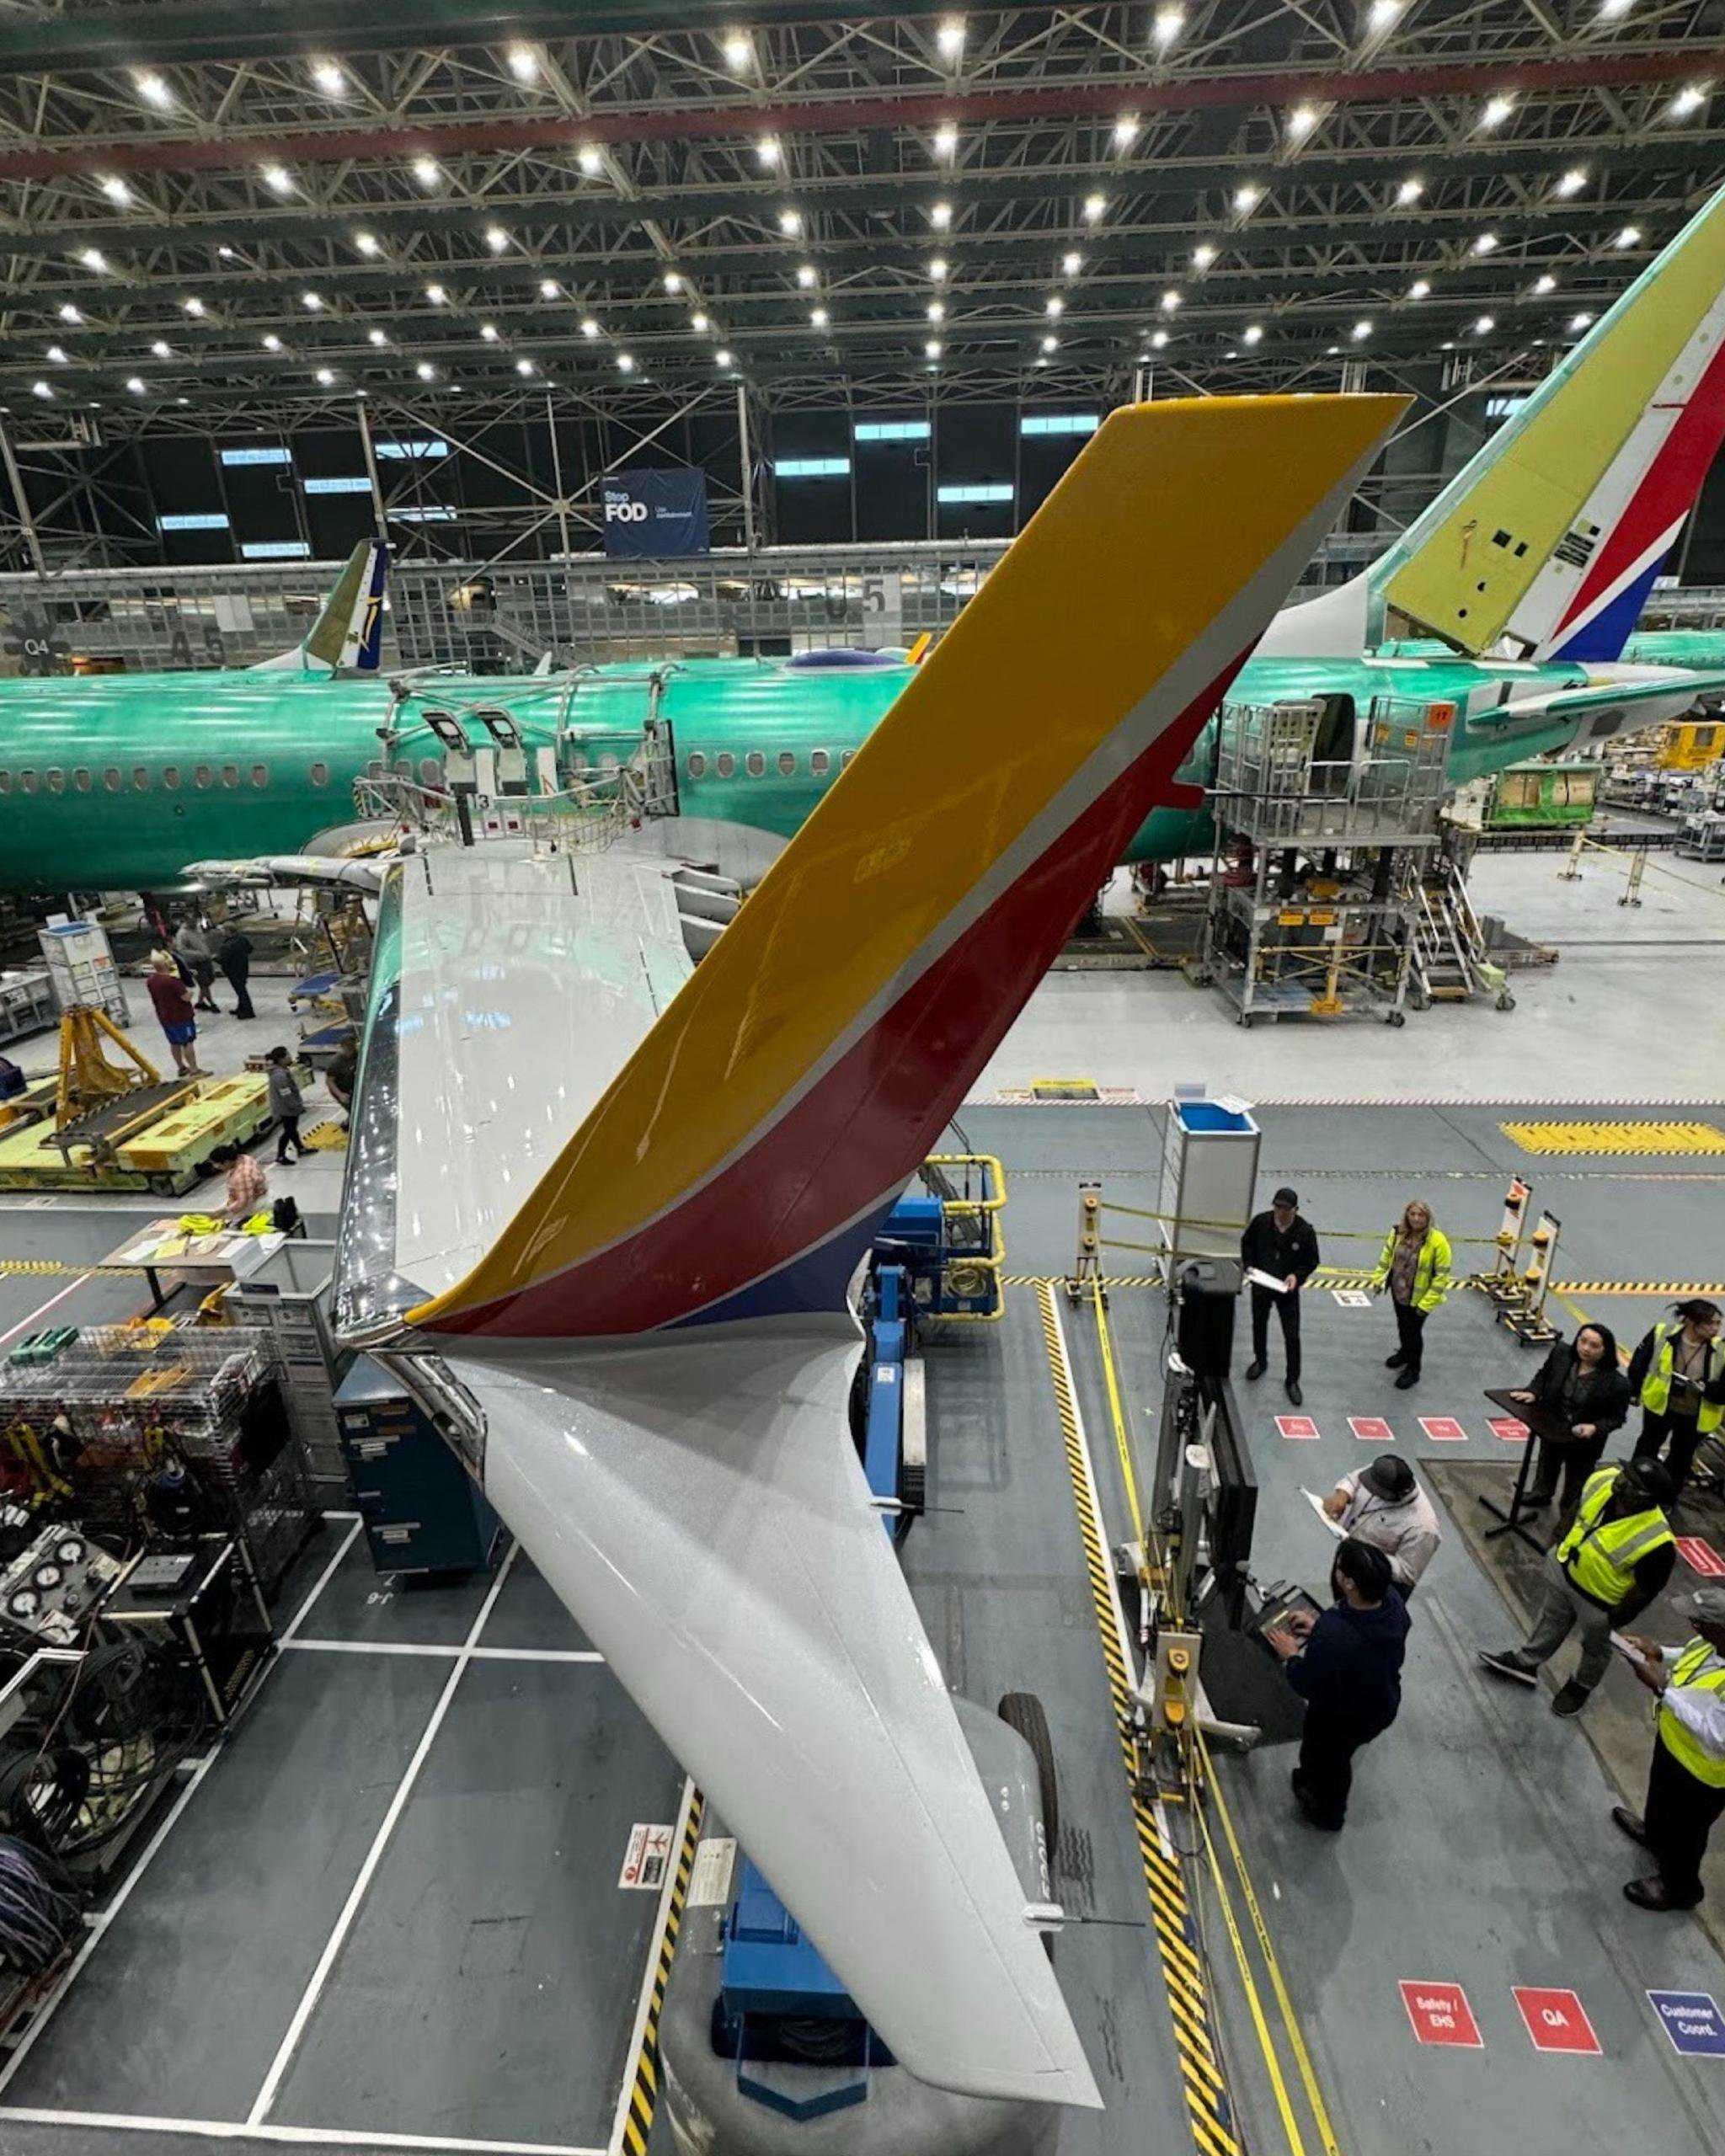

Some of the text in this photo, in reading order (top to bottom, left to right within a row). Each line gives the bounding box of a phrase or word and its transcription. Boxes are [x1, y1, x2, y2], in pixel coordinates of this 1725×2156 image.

[605, 490, 630, 503] Stop
[605, 502, 649, 523] FOD
[1416, 1997, 1451, 2014] Safety
[1659, 2003, 1714, 2020] Customer
[1429, 2014, 1456, 2029] EHS
[1541, 2008, 1570, 2027] QA
[1677, 2020, 1718, 2036] Coord.
